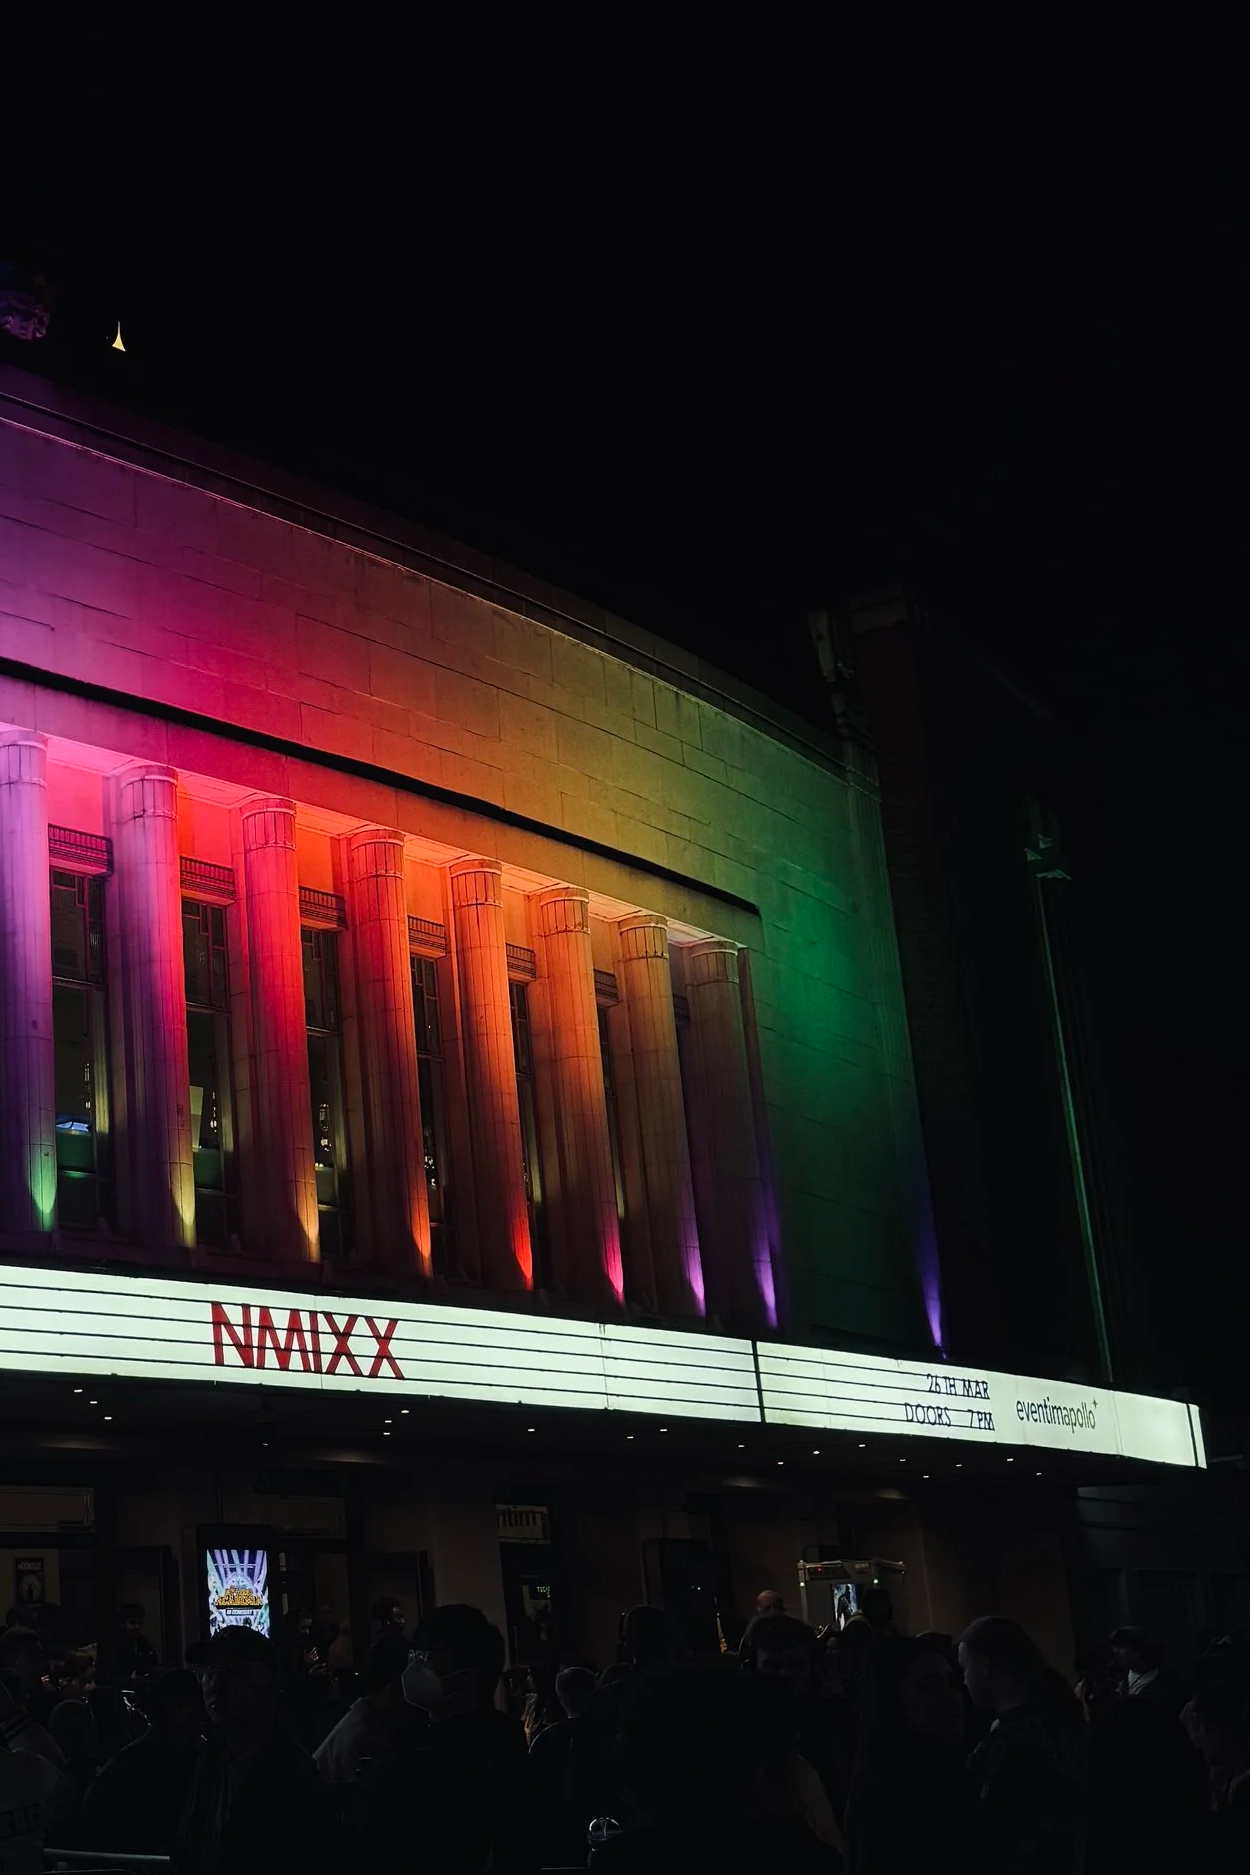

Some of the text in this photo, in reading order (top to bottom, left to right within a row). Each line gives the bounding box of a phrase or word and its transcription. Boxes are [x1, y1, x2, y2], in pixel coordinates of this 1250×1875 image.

[211, 1301, 405, 1380] NMIXX
[962, 1378, 990, 1399] MAR
[904, 1402, 951, 1427] DOORS
[1016, 1396, 1096, 1434] eventimapollo
